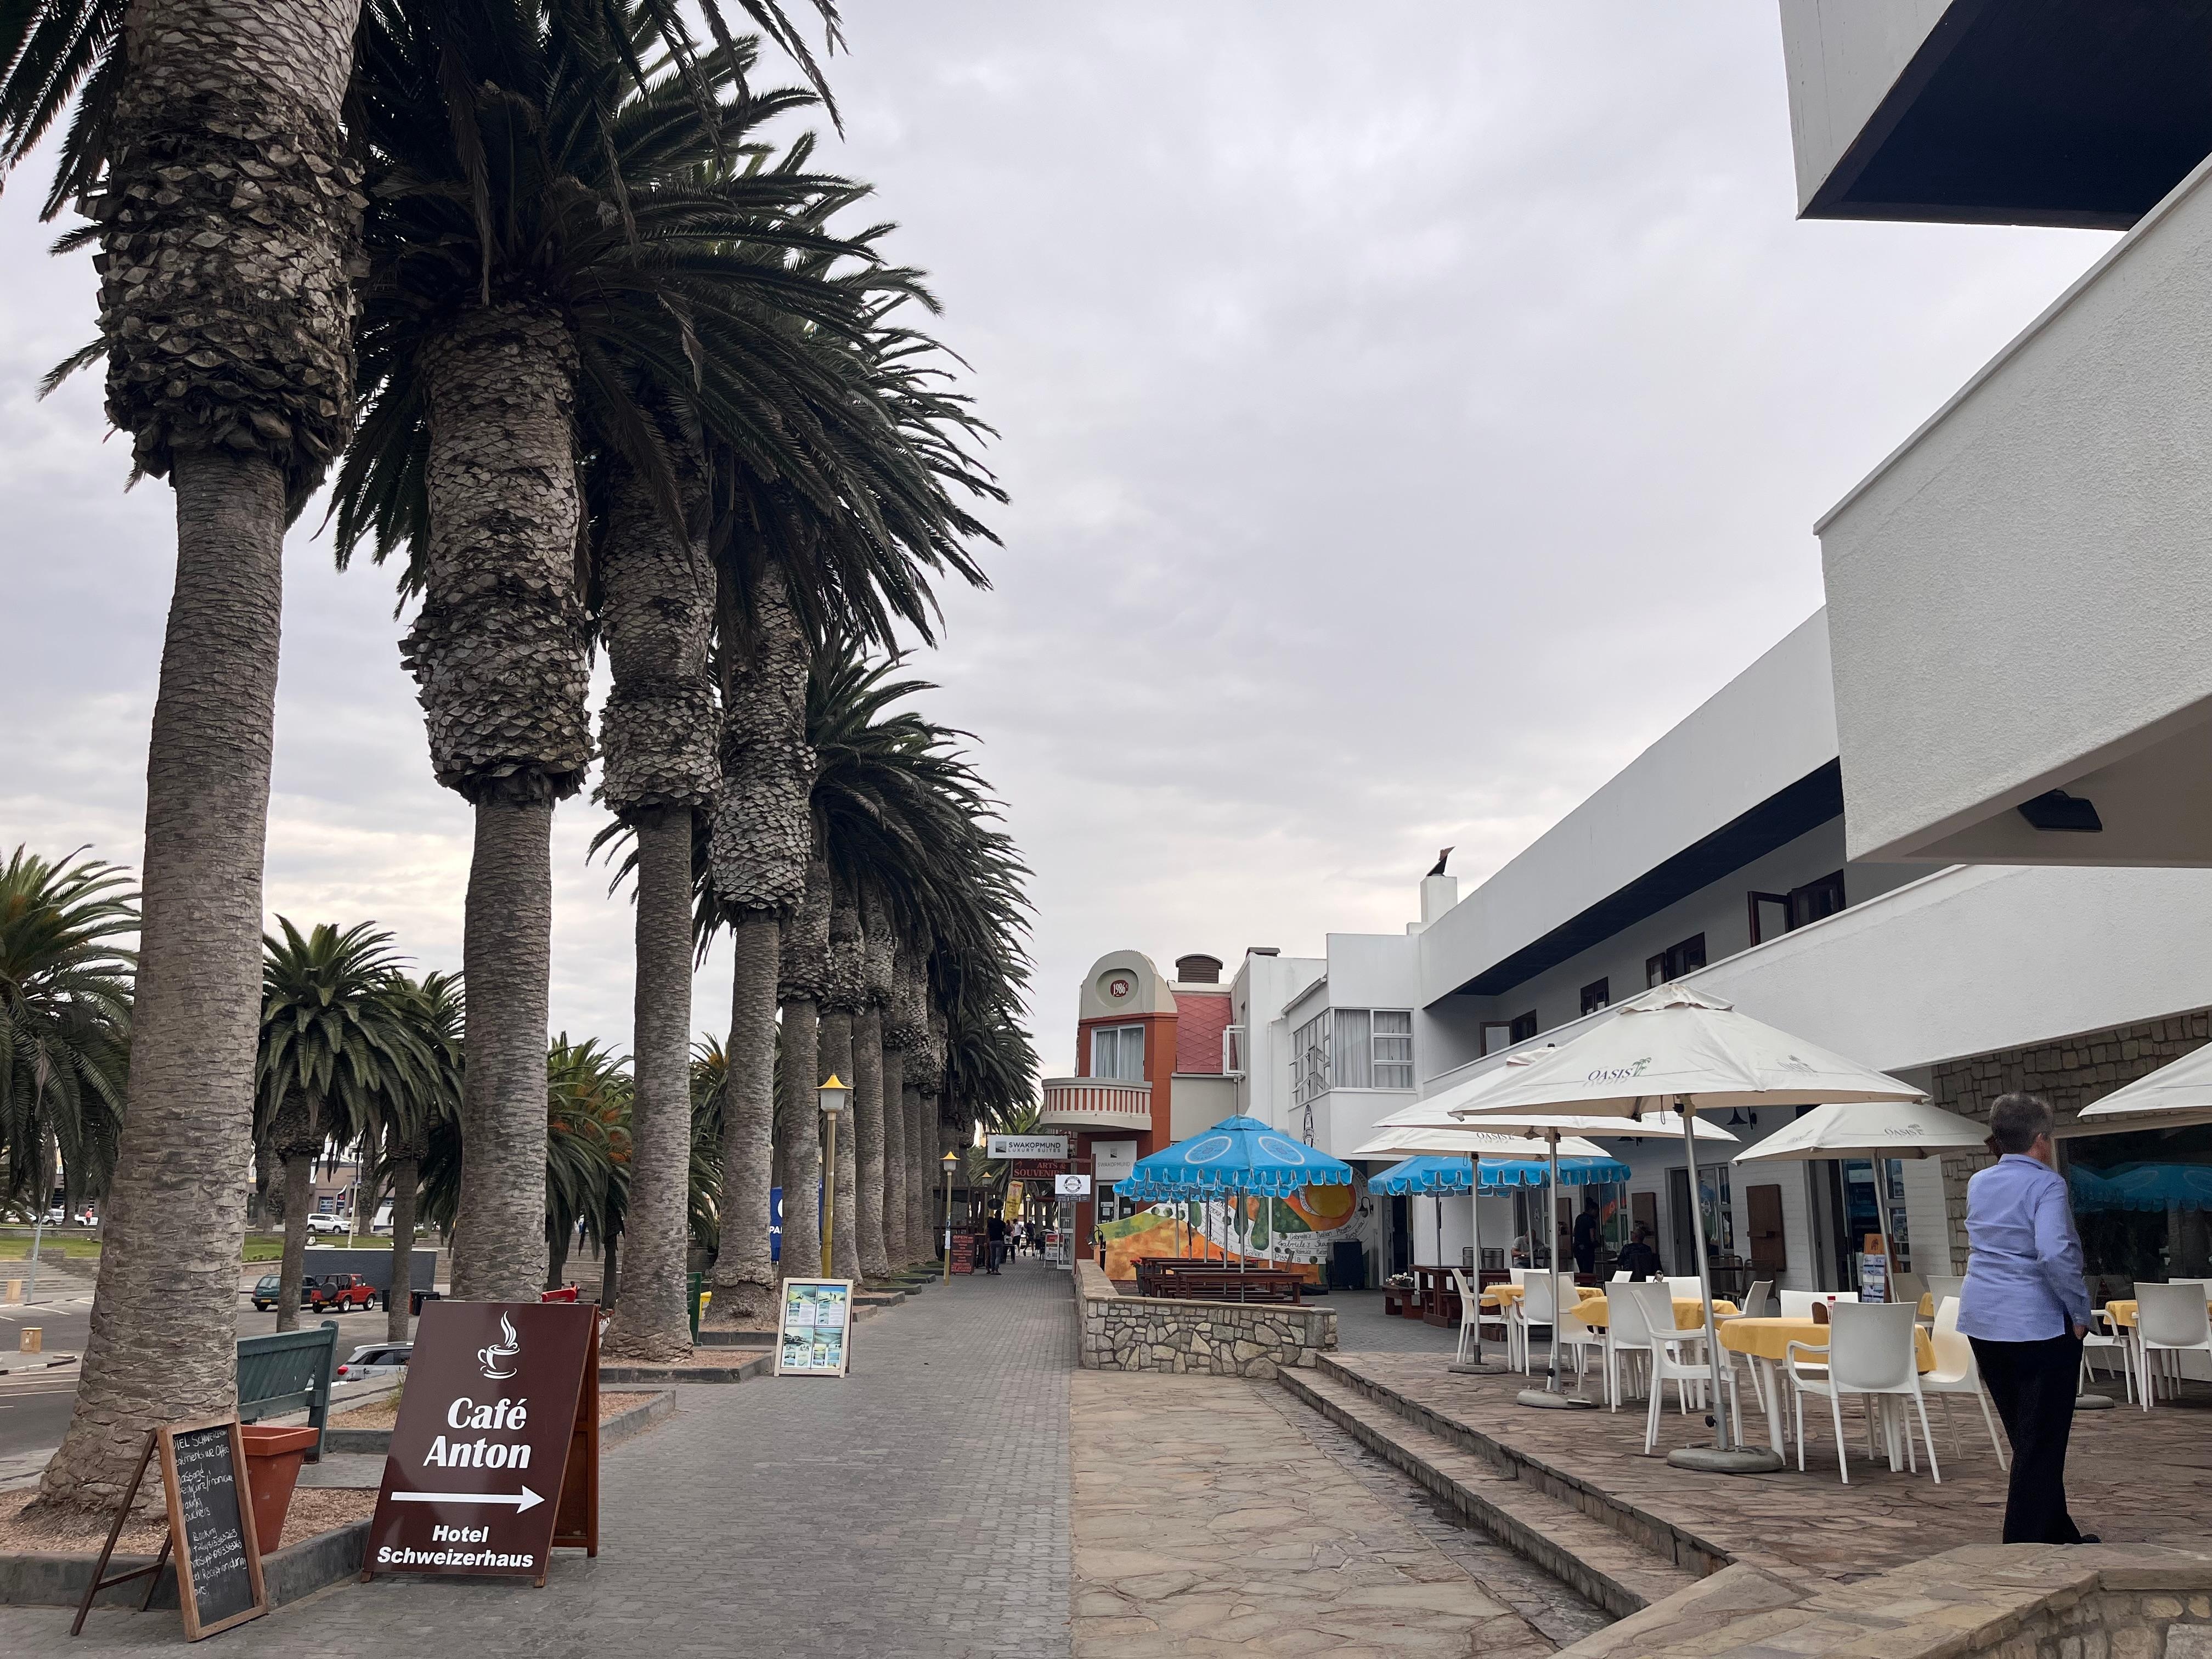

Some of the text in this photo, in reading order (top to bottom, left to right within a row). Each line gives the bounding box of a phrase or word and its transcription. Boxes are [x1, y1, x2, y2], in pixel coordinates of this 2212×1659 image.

[1113, 983, 1126, 995] 1986
[1588, 1068, 1633, 1081] OASIS
[1245, 1247, 1263, 1257] talian
[447, 1397, 527, 1430] Café
[423, 1435, 532, 1469] Anton
[432, 1525, 489, 1543] Hotel
[377, 1547, 534, 1567] Schweizerhaus
